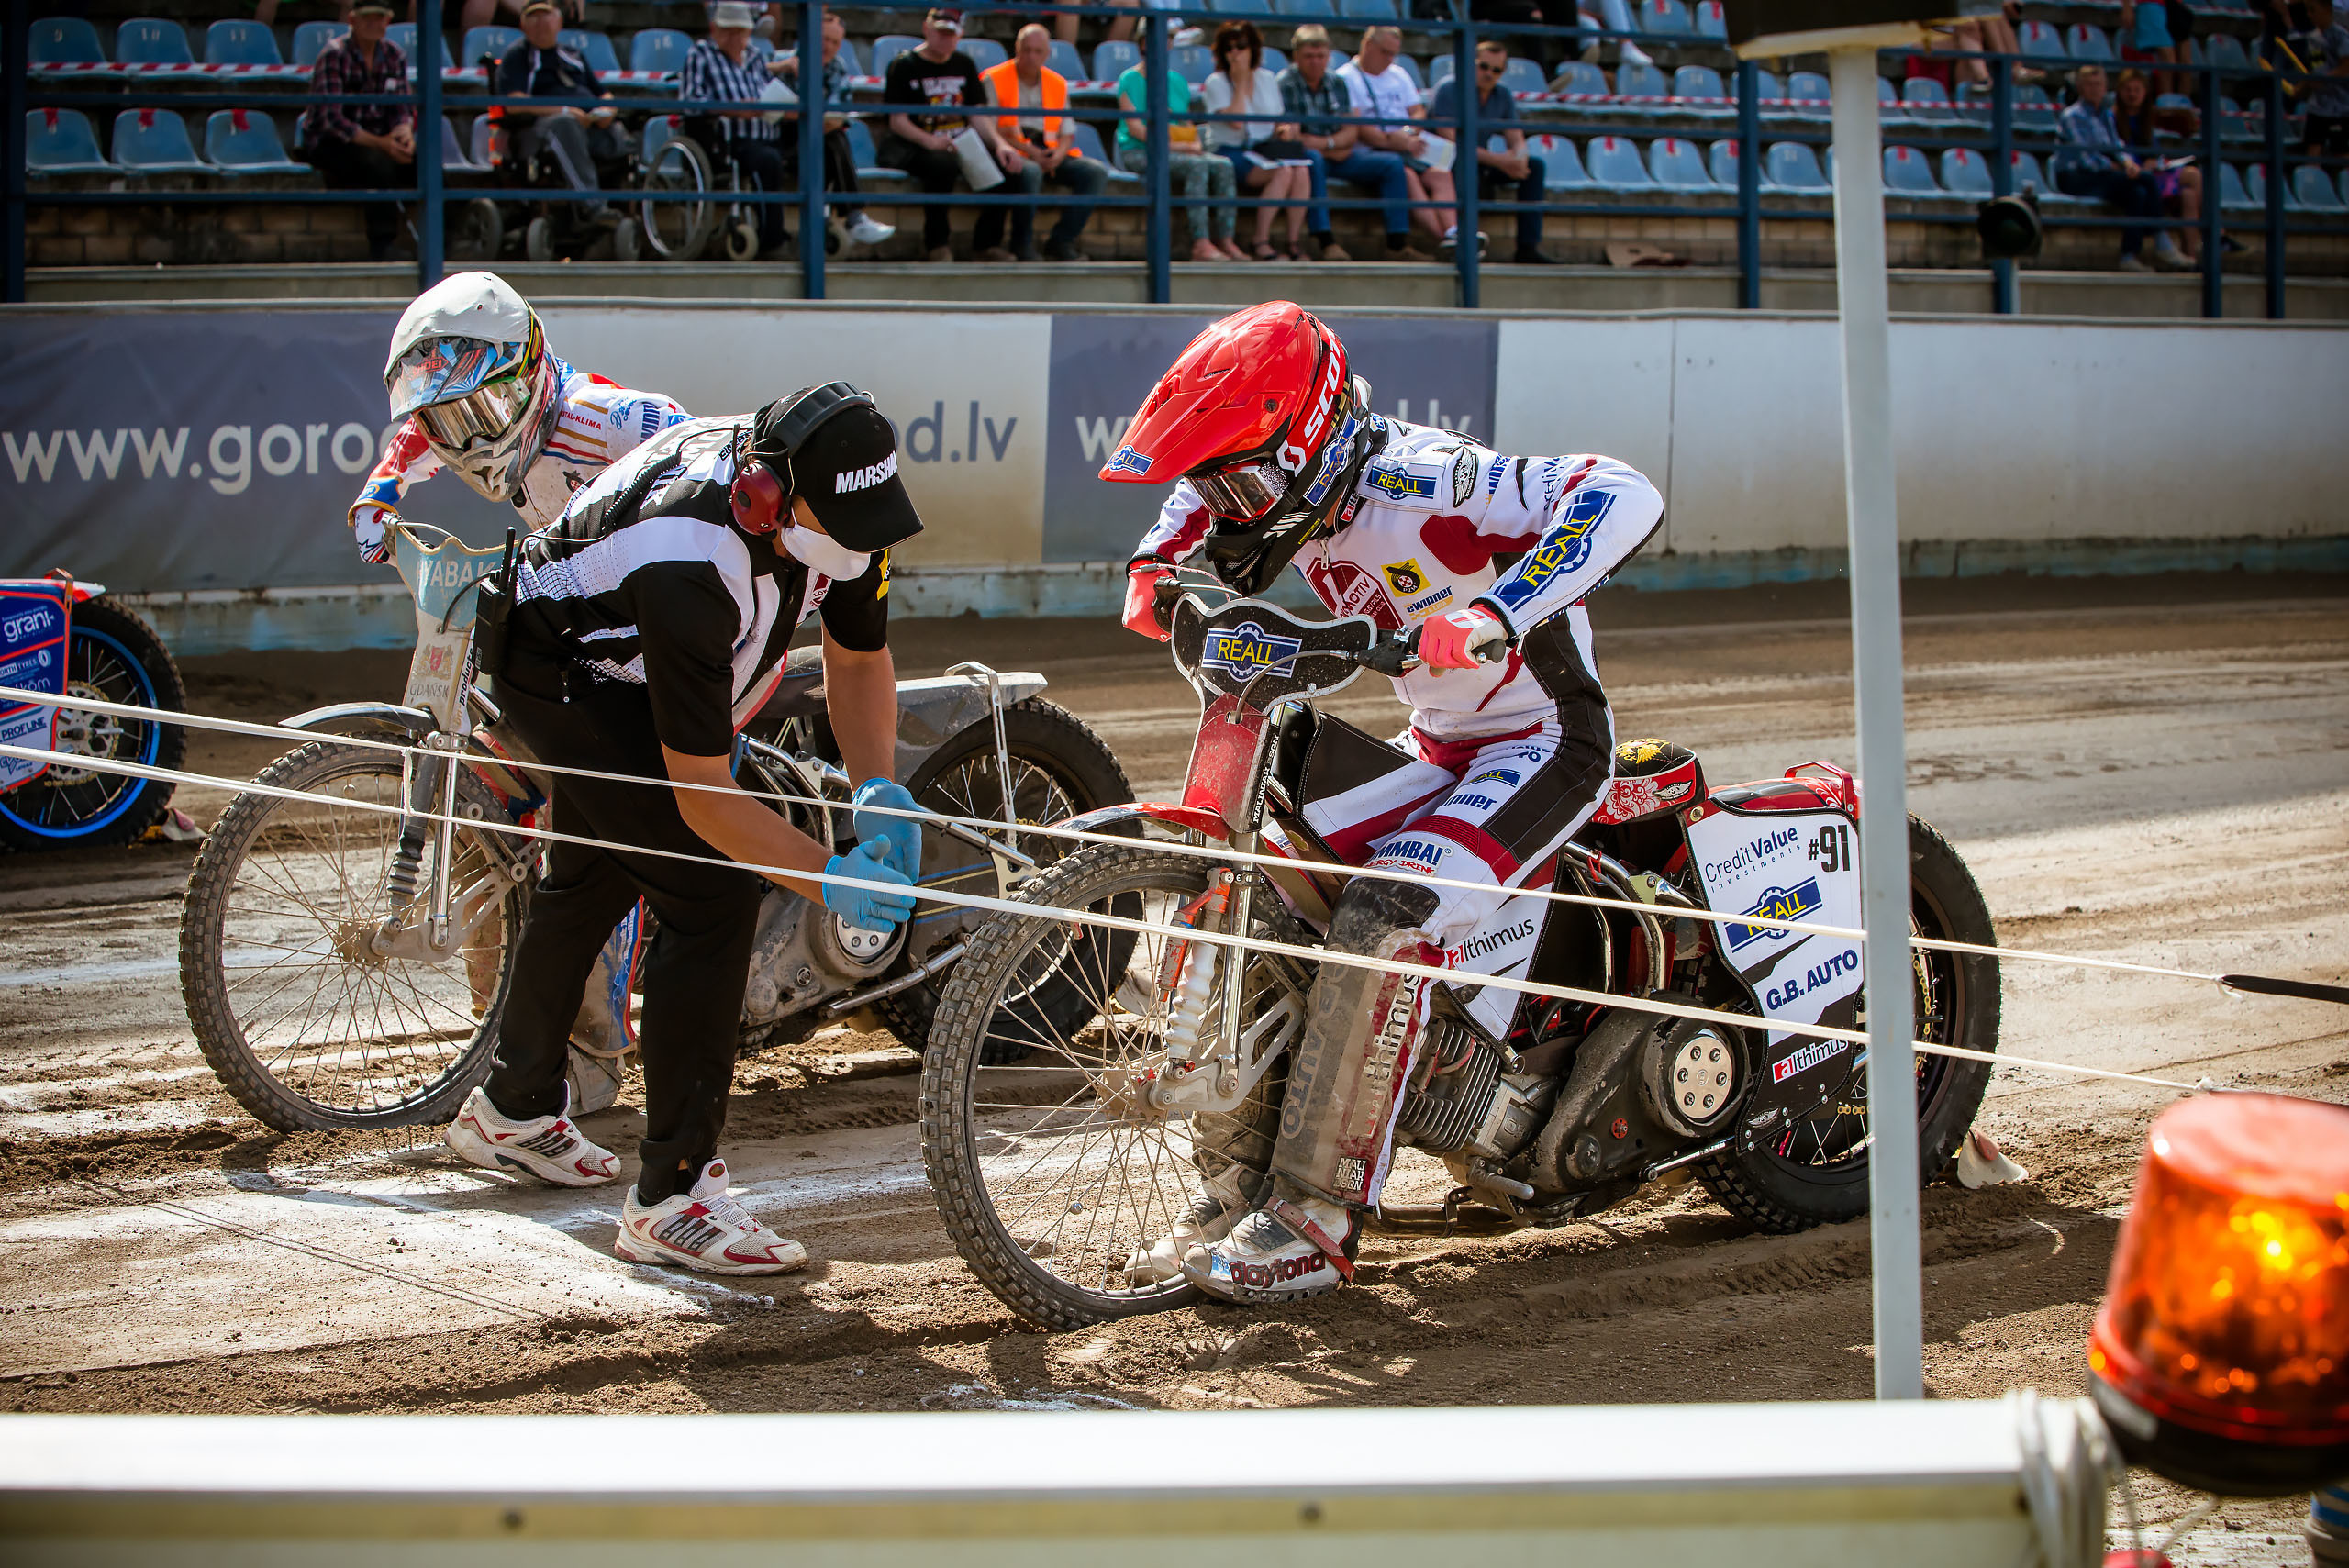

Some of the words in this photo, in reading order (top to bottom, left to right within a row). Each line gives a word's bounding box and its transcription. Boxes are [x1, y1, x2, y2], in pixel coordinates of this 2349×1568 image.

[891, 400, 1018, 463] d.lv
[1376, 473, 1422, 494] REALL
[1520, 514, 1597, 587] REALL
[1217, 638, 1275, 665] REALL
[1808, 824, 1851, 873] #91
[1452, 917, 1535, 966] althimus
[1766, 978, 1806, 1011] G.B.
[1807, 949, 1859, 993] AUTO
[1780, 1039, 1849, 1079] althimus
[1229, 1251, 1326, 1289] daytona
